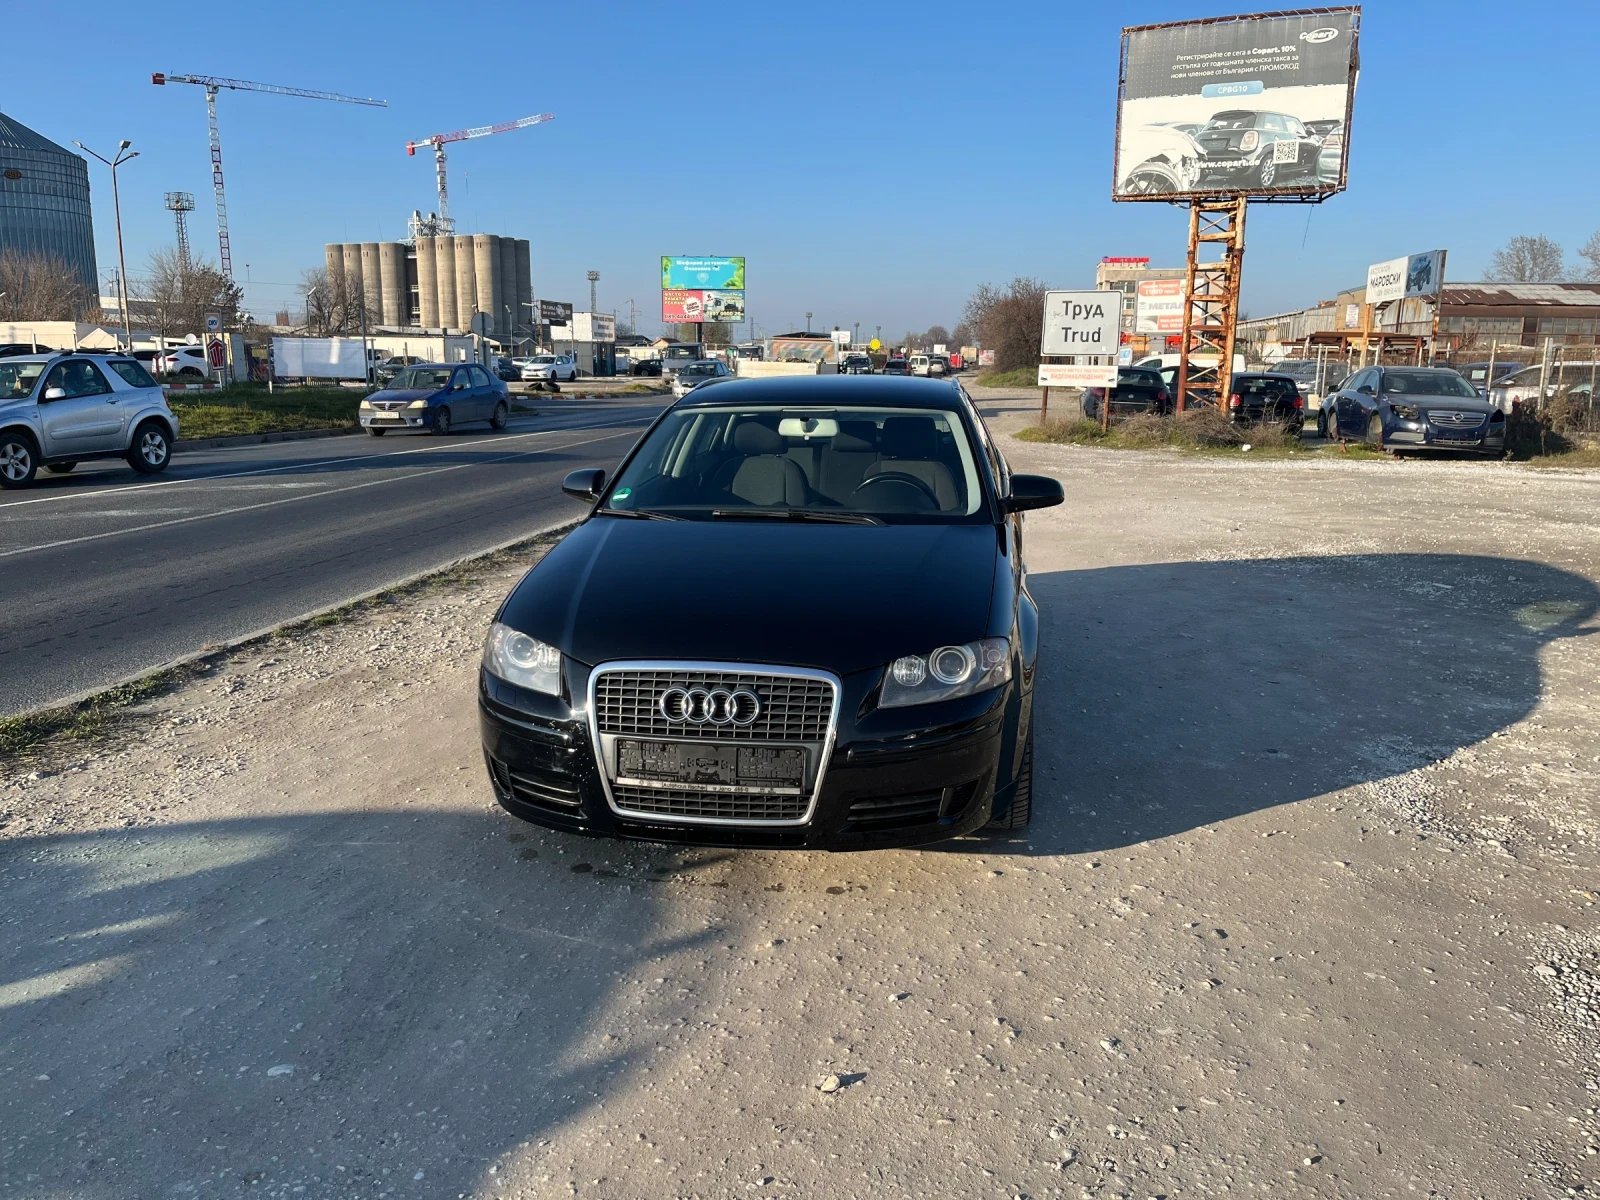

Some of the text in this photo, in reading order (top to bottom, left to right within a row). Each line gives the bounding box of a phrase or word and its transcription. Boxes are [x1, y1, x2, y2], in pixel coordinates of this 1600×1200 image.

[1299, 28, 1336, 42] Copart
[1176, 51, 1223, 61] Регистрирайте
[1252, 47, 1280, 56] Copart.
[1280, 45, 1297, 53] 10%
[1170, 71, 1187, 79] нови
[1187, 69, 1215, 77] членове
[1222, 67, 1254, 76] България
[1259, 62, 1300, 72] ПРОМОКОД
[1172, 62, 1201, 71] отстъпка
[1210, 58, 1244, 67] годишната
[1245, 56, 1272, 64] членска
[1217, 85, 1248, 95] CPBG10
[1370, 271, 1402, 288] МАРОВСКИ
[1062, 300, 1104, 319] Труд
[1061, 327, 1102, 343] Trud
[663, 781, 687, 789] Autohaus
